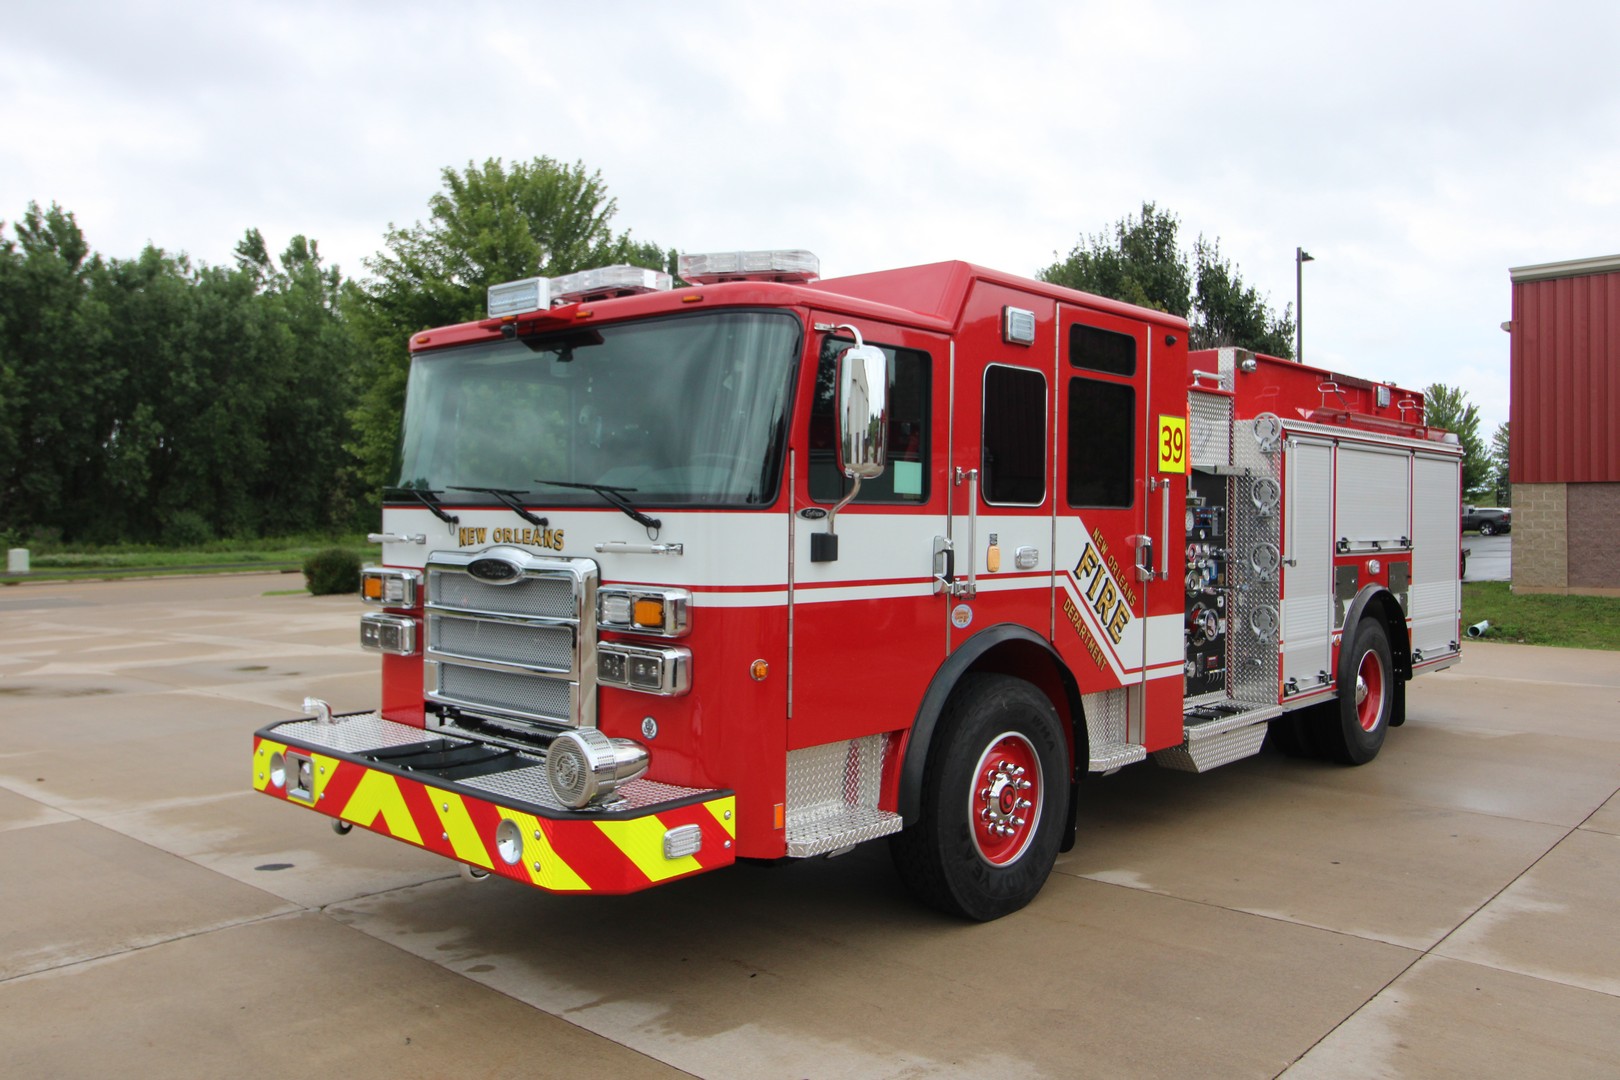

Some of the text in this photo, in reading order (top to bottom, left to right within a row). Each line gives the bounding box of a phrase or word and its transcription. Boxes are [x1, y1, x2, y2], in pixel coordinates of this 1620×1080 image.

[1161, 425, 1184, 463] 39
[459, 527, 564, 551] NEW ORLEANS
[1092, 527, 1137, 607] NEW ORLEANS
[1073, 542, 1131, 645] FIRE
[1063, 598, 1108, 672] DEPARTMENT
